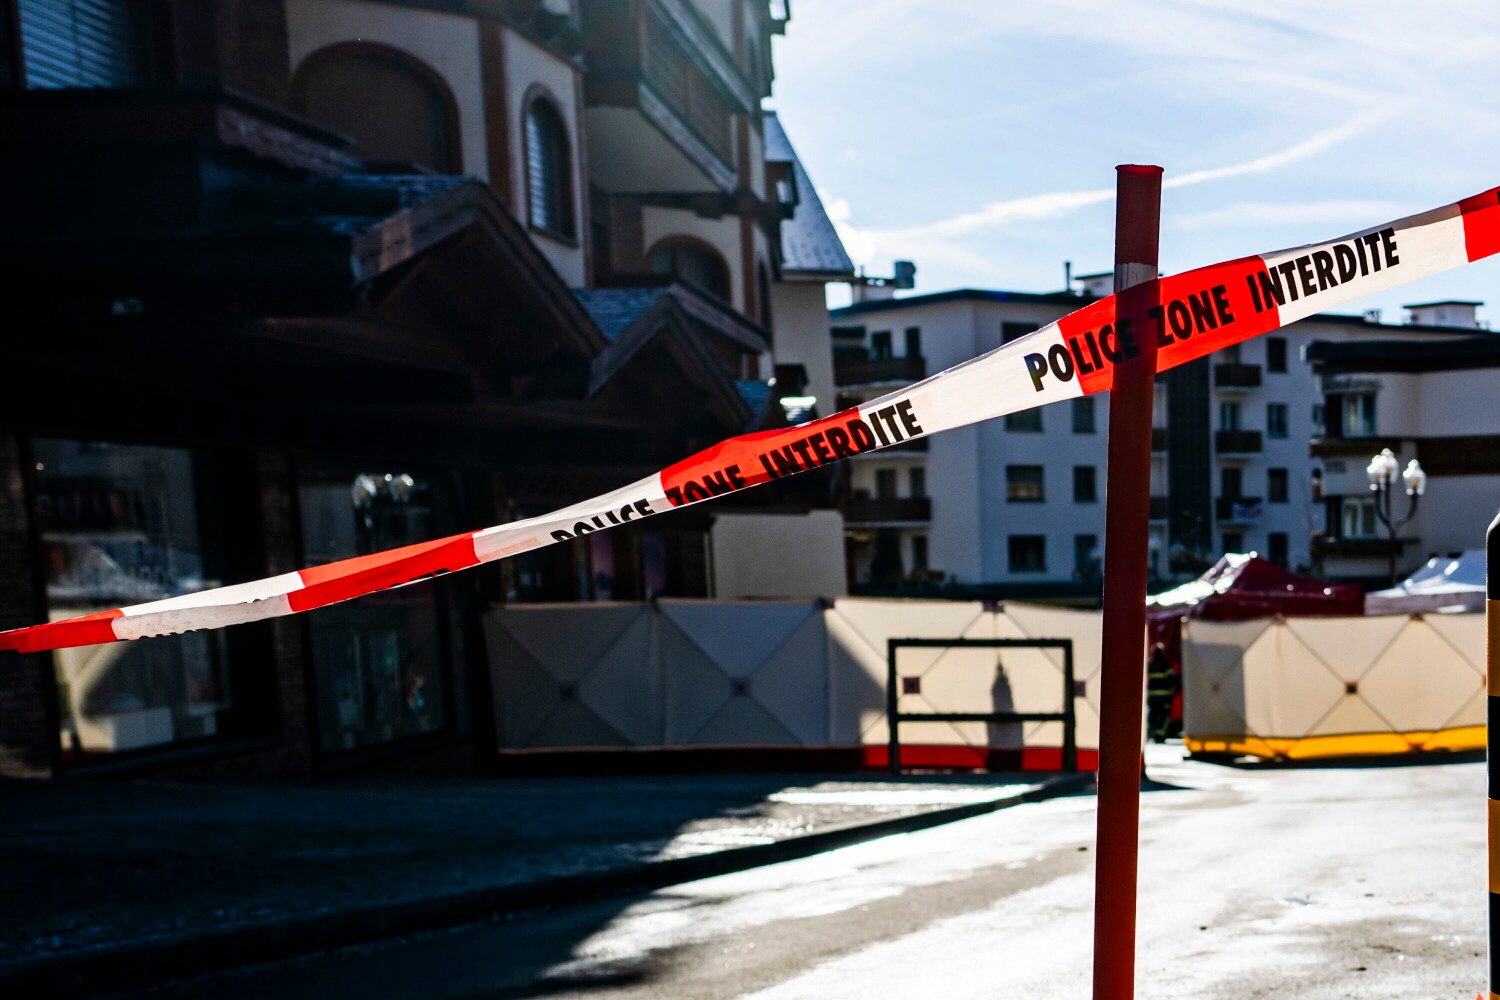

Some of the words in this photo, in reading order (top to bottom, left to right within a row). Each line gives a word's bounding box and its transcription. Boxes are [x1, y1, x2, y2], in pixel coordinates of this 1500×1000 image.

[1024, 318, 1139, 392] POLICE
[1148, 284, 1236, 348] ZONE
[1246, 227, 1400, 314] INTERDITE
[759, 399, 923, 480] INTERDITE
